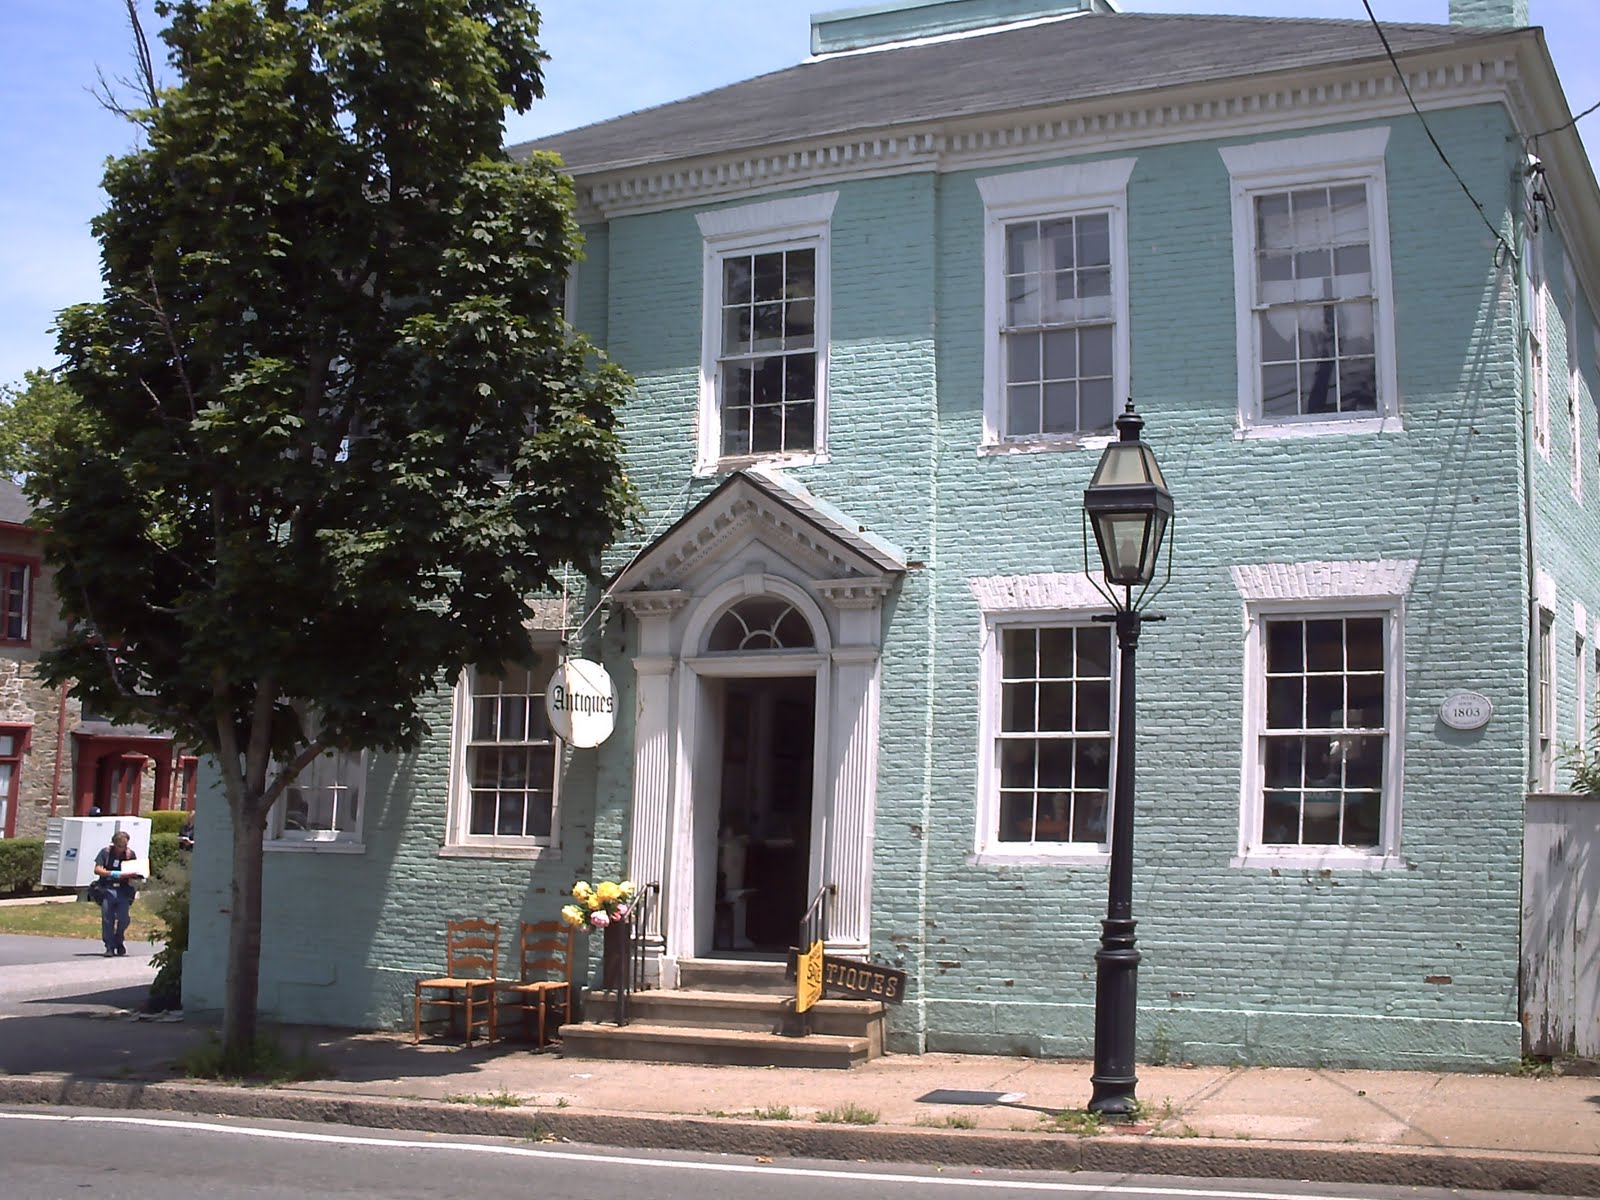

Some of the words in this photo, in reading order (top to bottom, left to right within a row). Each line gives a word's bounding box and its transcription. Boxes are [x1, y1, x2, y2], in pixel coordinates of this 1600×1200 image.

[553, 685, 613, 716] Antiques
[1454, 707, 1480, 717] 1803
[826, 963, 898, 997] TIQUES
